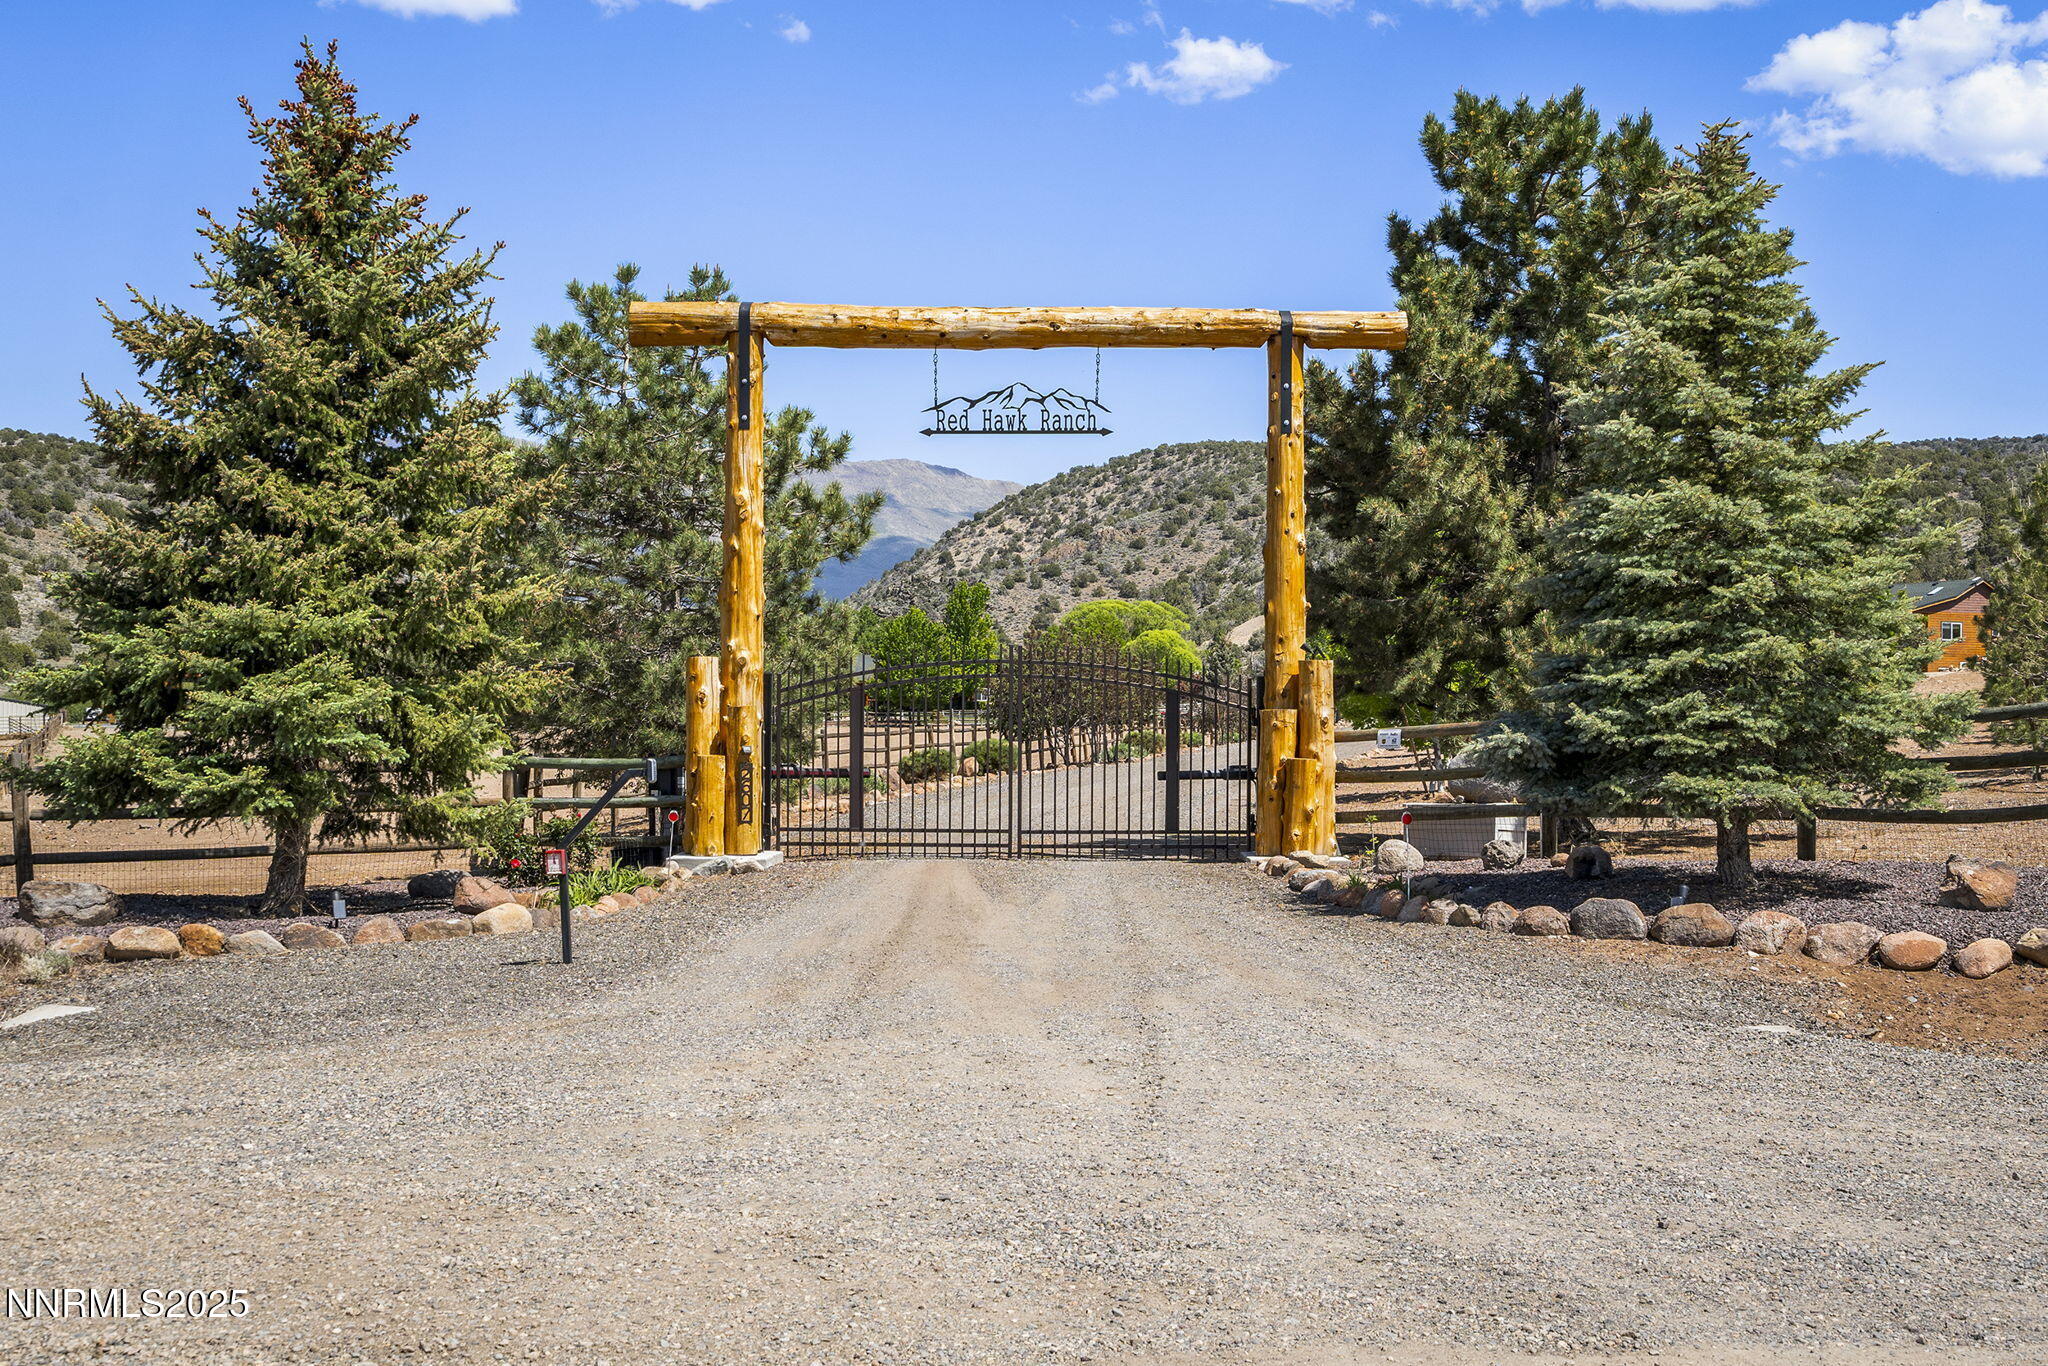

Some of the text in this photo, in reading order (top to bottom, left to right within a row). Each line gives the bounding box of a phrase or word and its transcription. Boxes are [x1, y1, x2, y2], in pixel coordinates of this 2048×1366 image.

[936, 409, 1097, 430] Red Hawk Ranch
